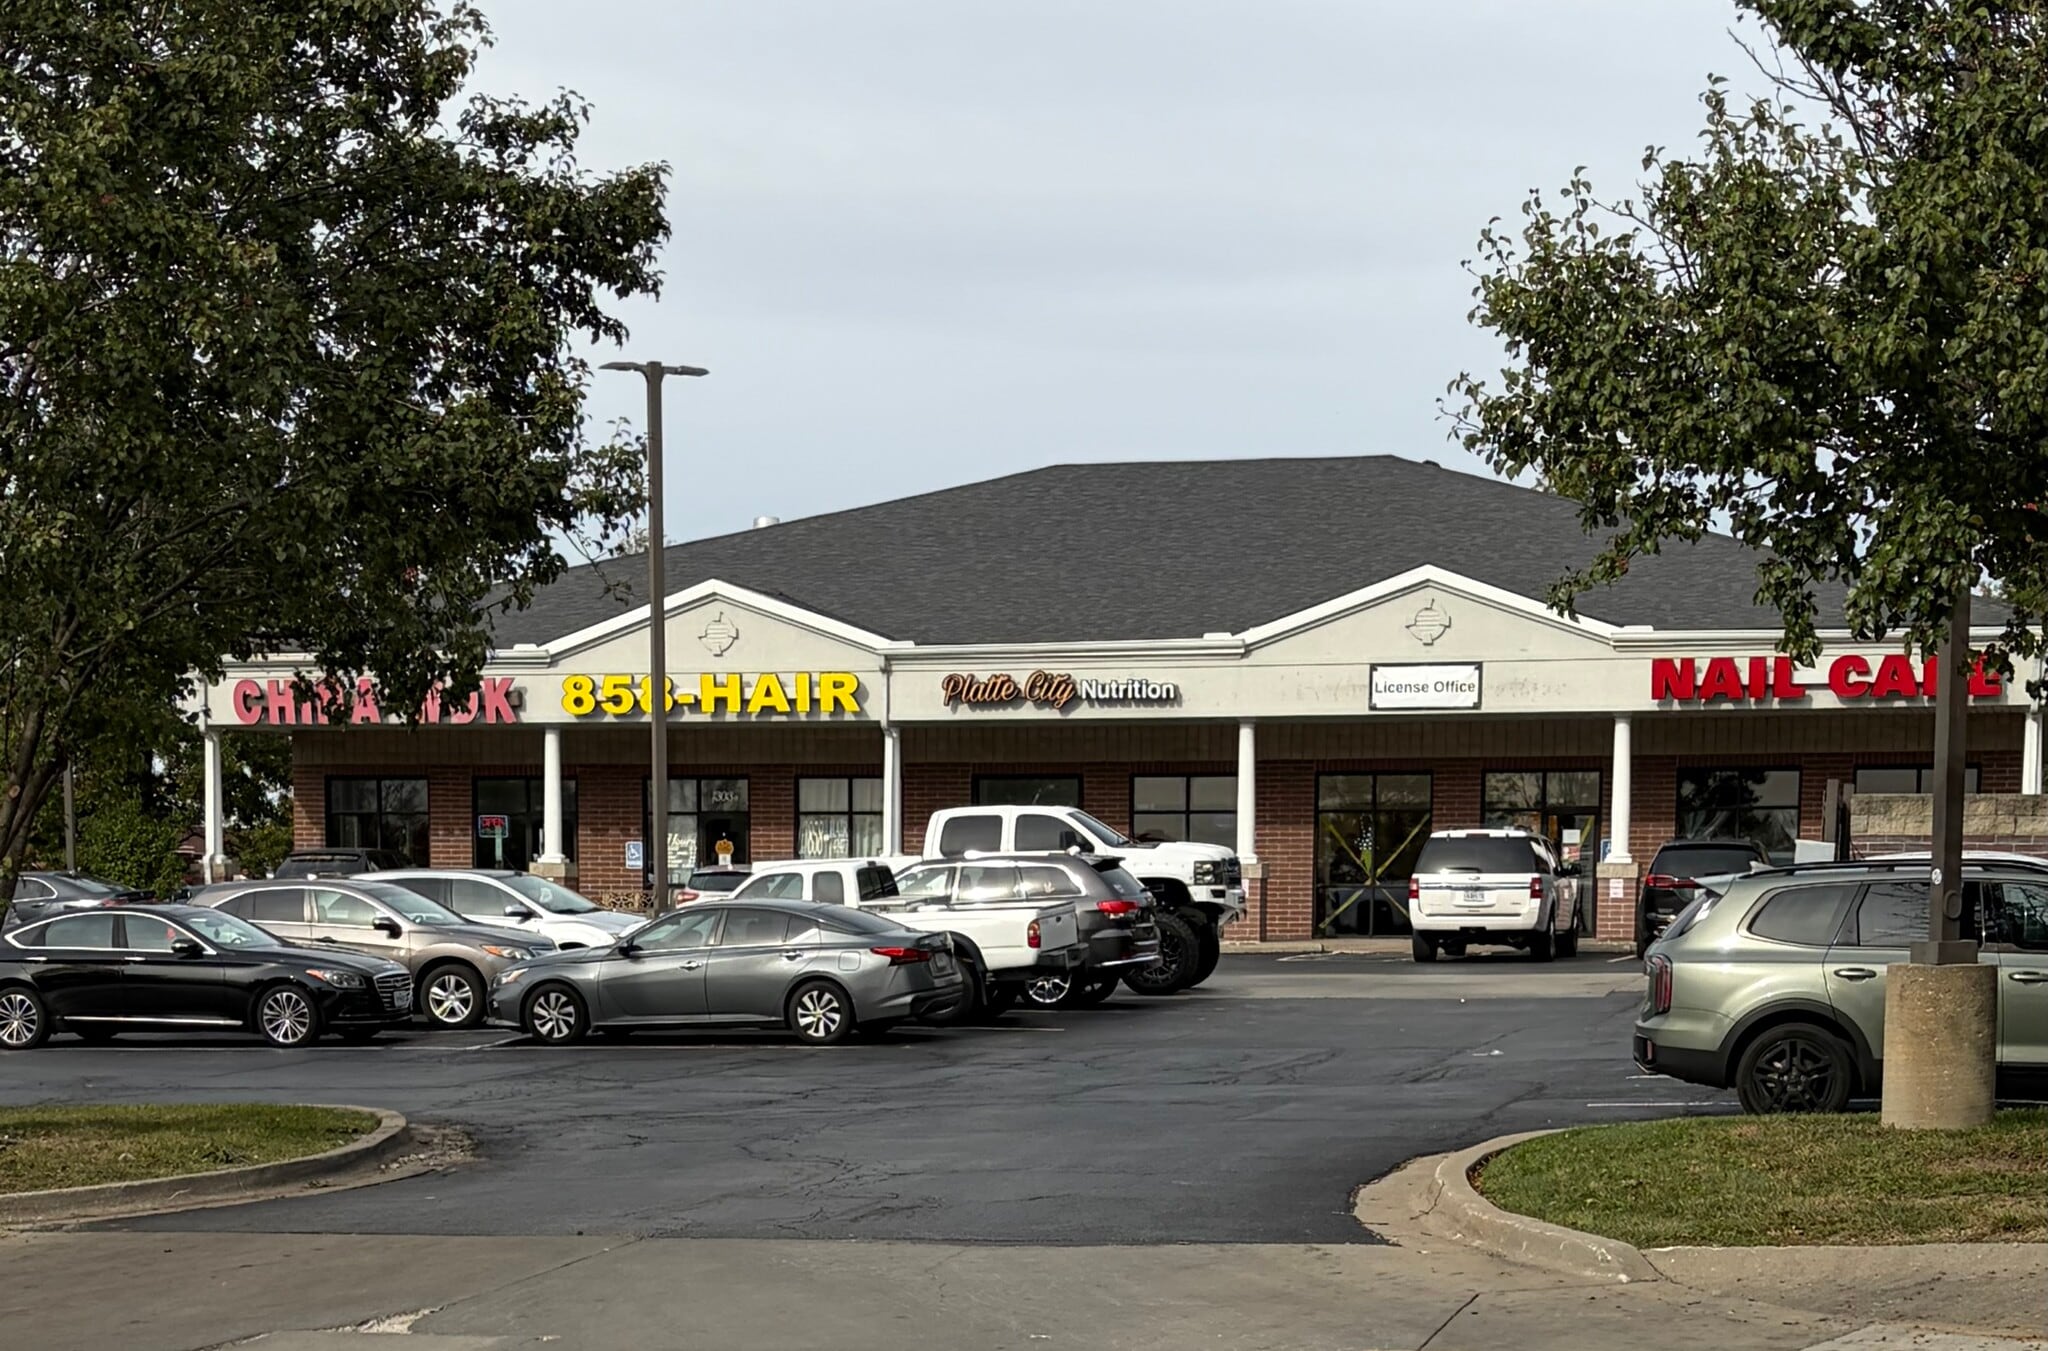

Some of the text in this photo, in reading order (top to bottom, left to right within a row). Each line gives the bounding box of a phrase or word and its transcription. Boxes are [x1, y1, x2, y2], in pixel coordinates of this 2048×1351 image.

[561, 672, 860, 716] 858-HAIR
[942, 669, 1175, 709] Platte City Nutrition
[1375, 680, 1476, 694] License Office
[1651, 657, 1805, 700] NAIL
